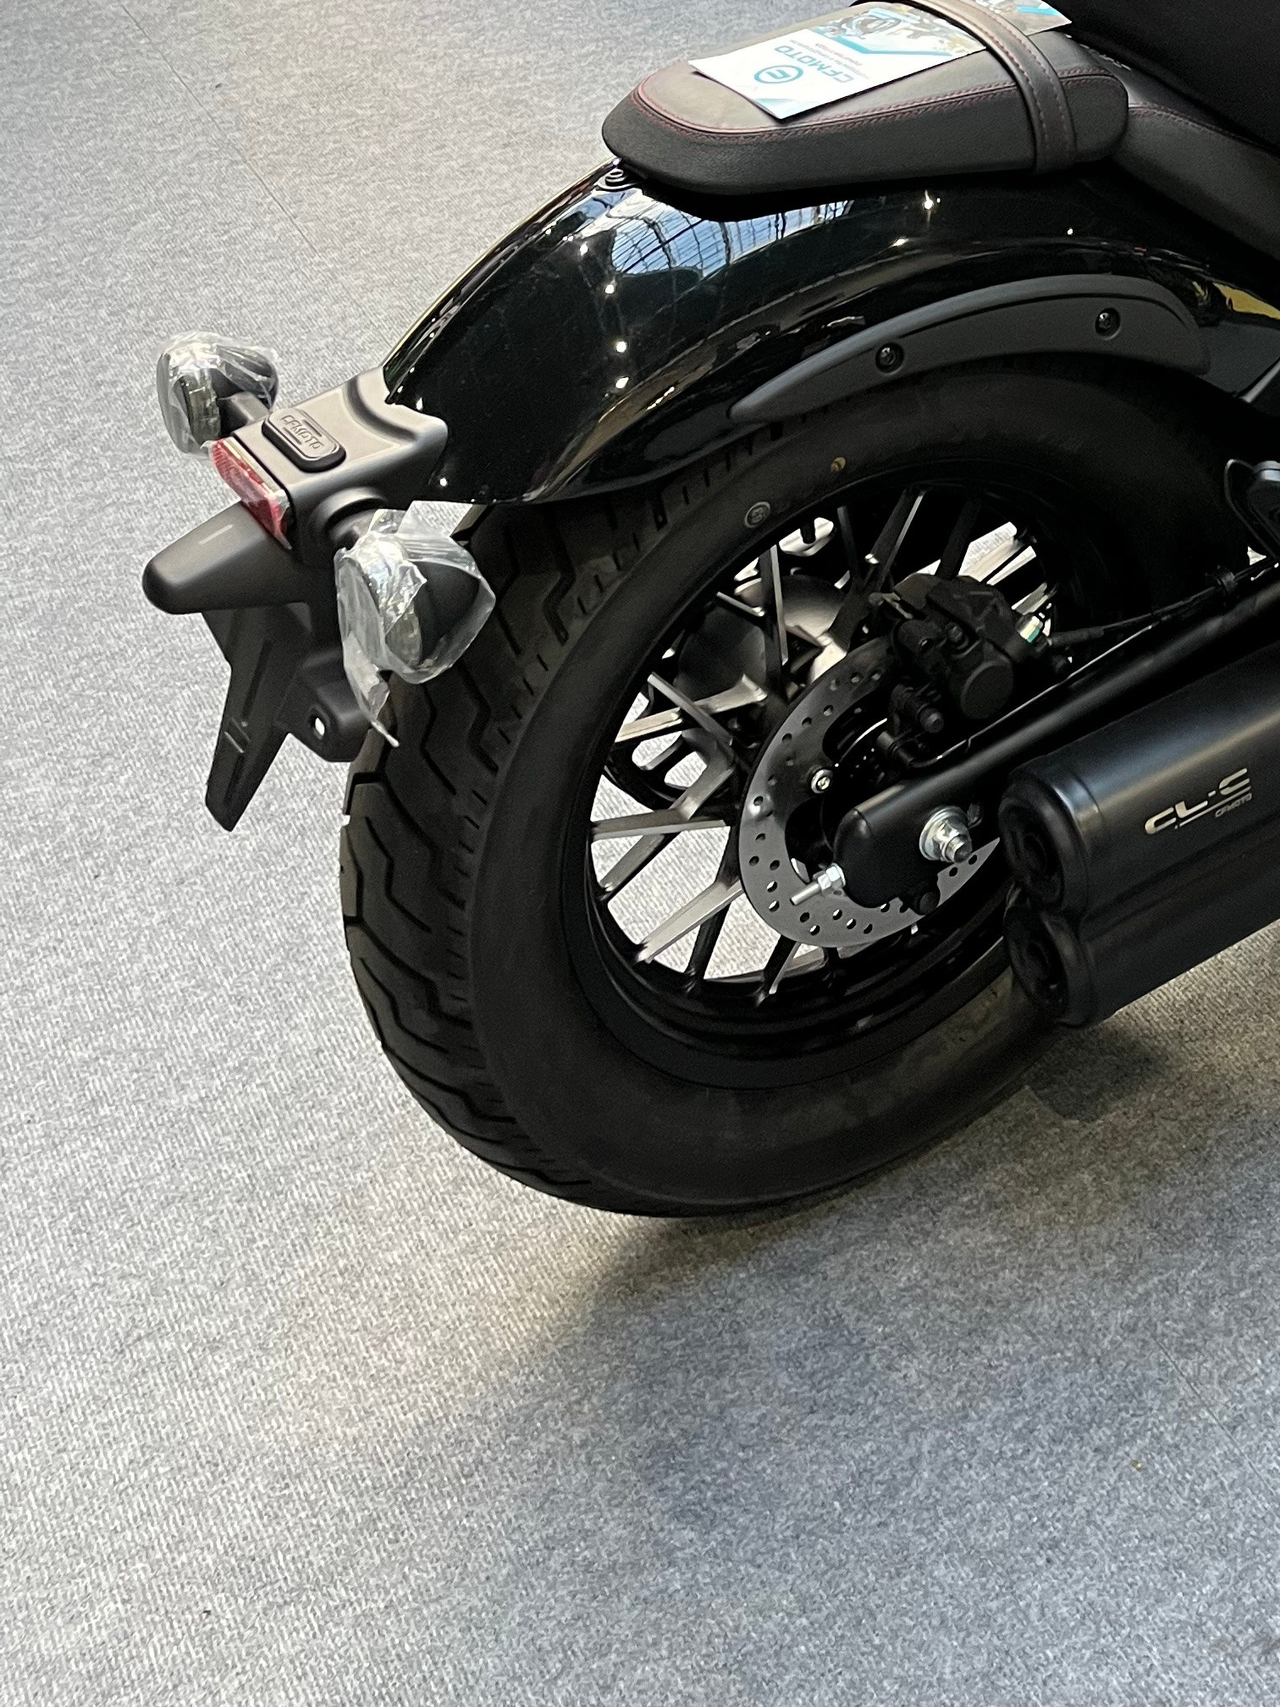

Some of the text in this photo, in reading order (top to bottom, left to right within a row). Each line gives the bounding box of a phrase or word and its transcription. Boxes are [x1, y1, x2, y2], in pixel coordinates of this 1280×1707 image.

[774, 44, 855, 84] CFMOTO
[1144, 767, 1251, 835] CL-C
[1214, 792, 1253, 818] CFMOTO
